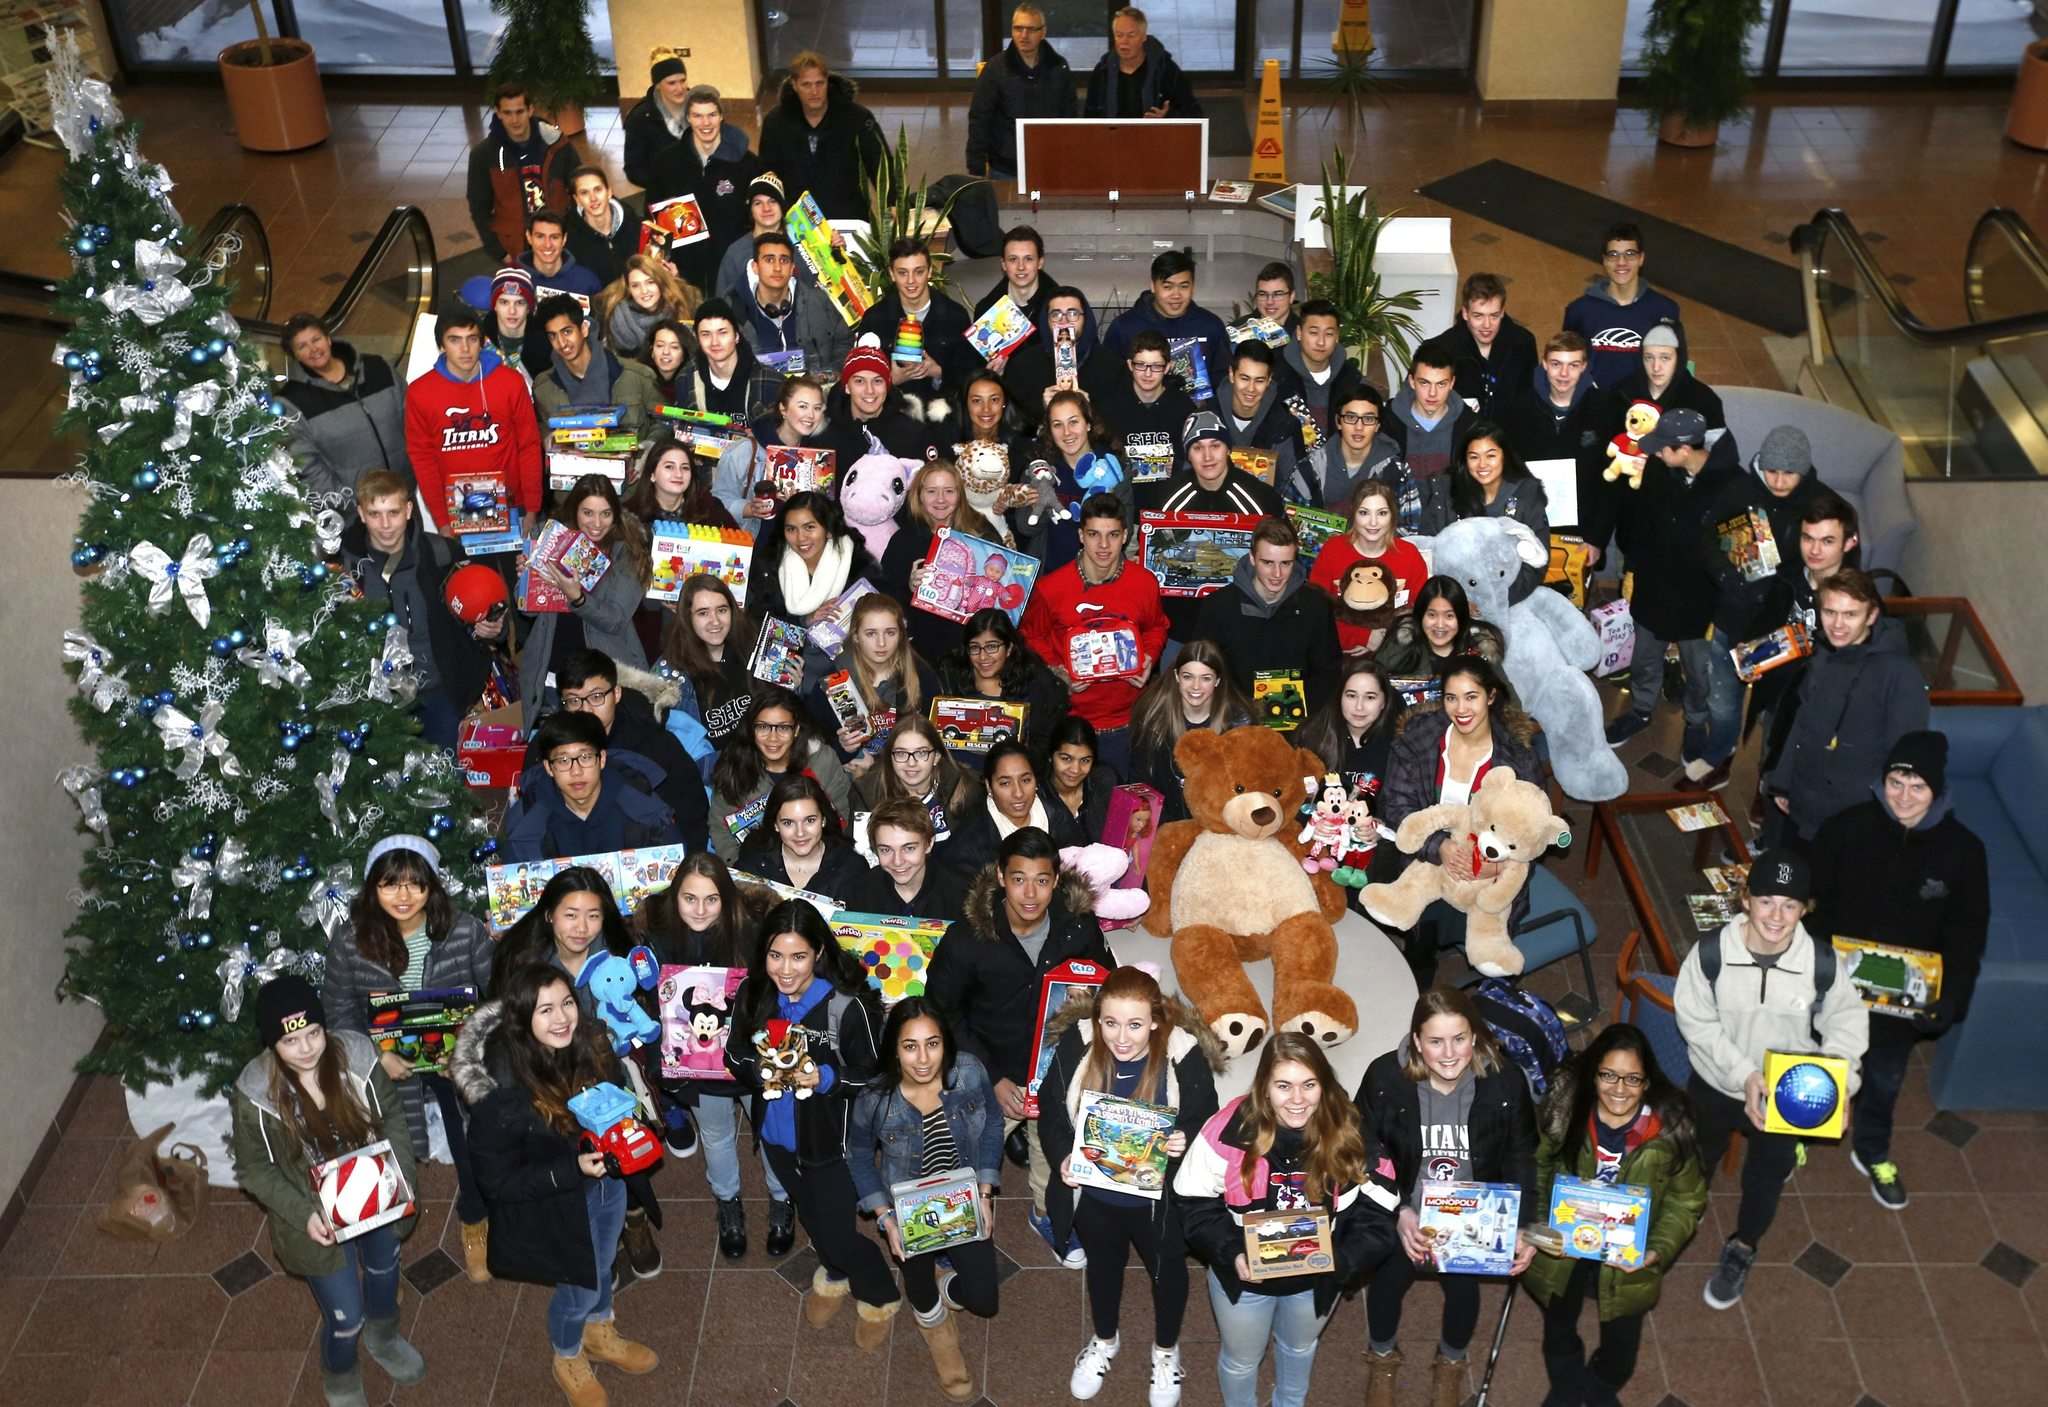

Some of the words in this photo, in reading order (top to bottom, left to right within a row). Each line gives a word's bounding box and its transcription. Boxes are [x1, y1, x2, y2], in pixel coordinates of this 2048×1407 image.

[443, 423, 500, 447] TITANS
[1126, 431, 1171, 446] SHS
[920, 586, 937, 600] KID
[708, 727, 730, 738] Class
[468, 772, 489, 782] KID
[1072, 964, 1095, 973] KID
[283, 1016, 307, 1034] 106
[1420, 1124, 1470, 1150] ITAN
[1426, 1198, 1478, 1208] MONOPOLY
